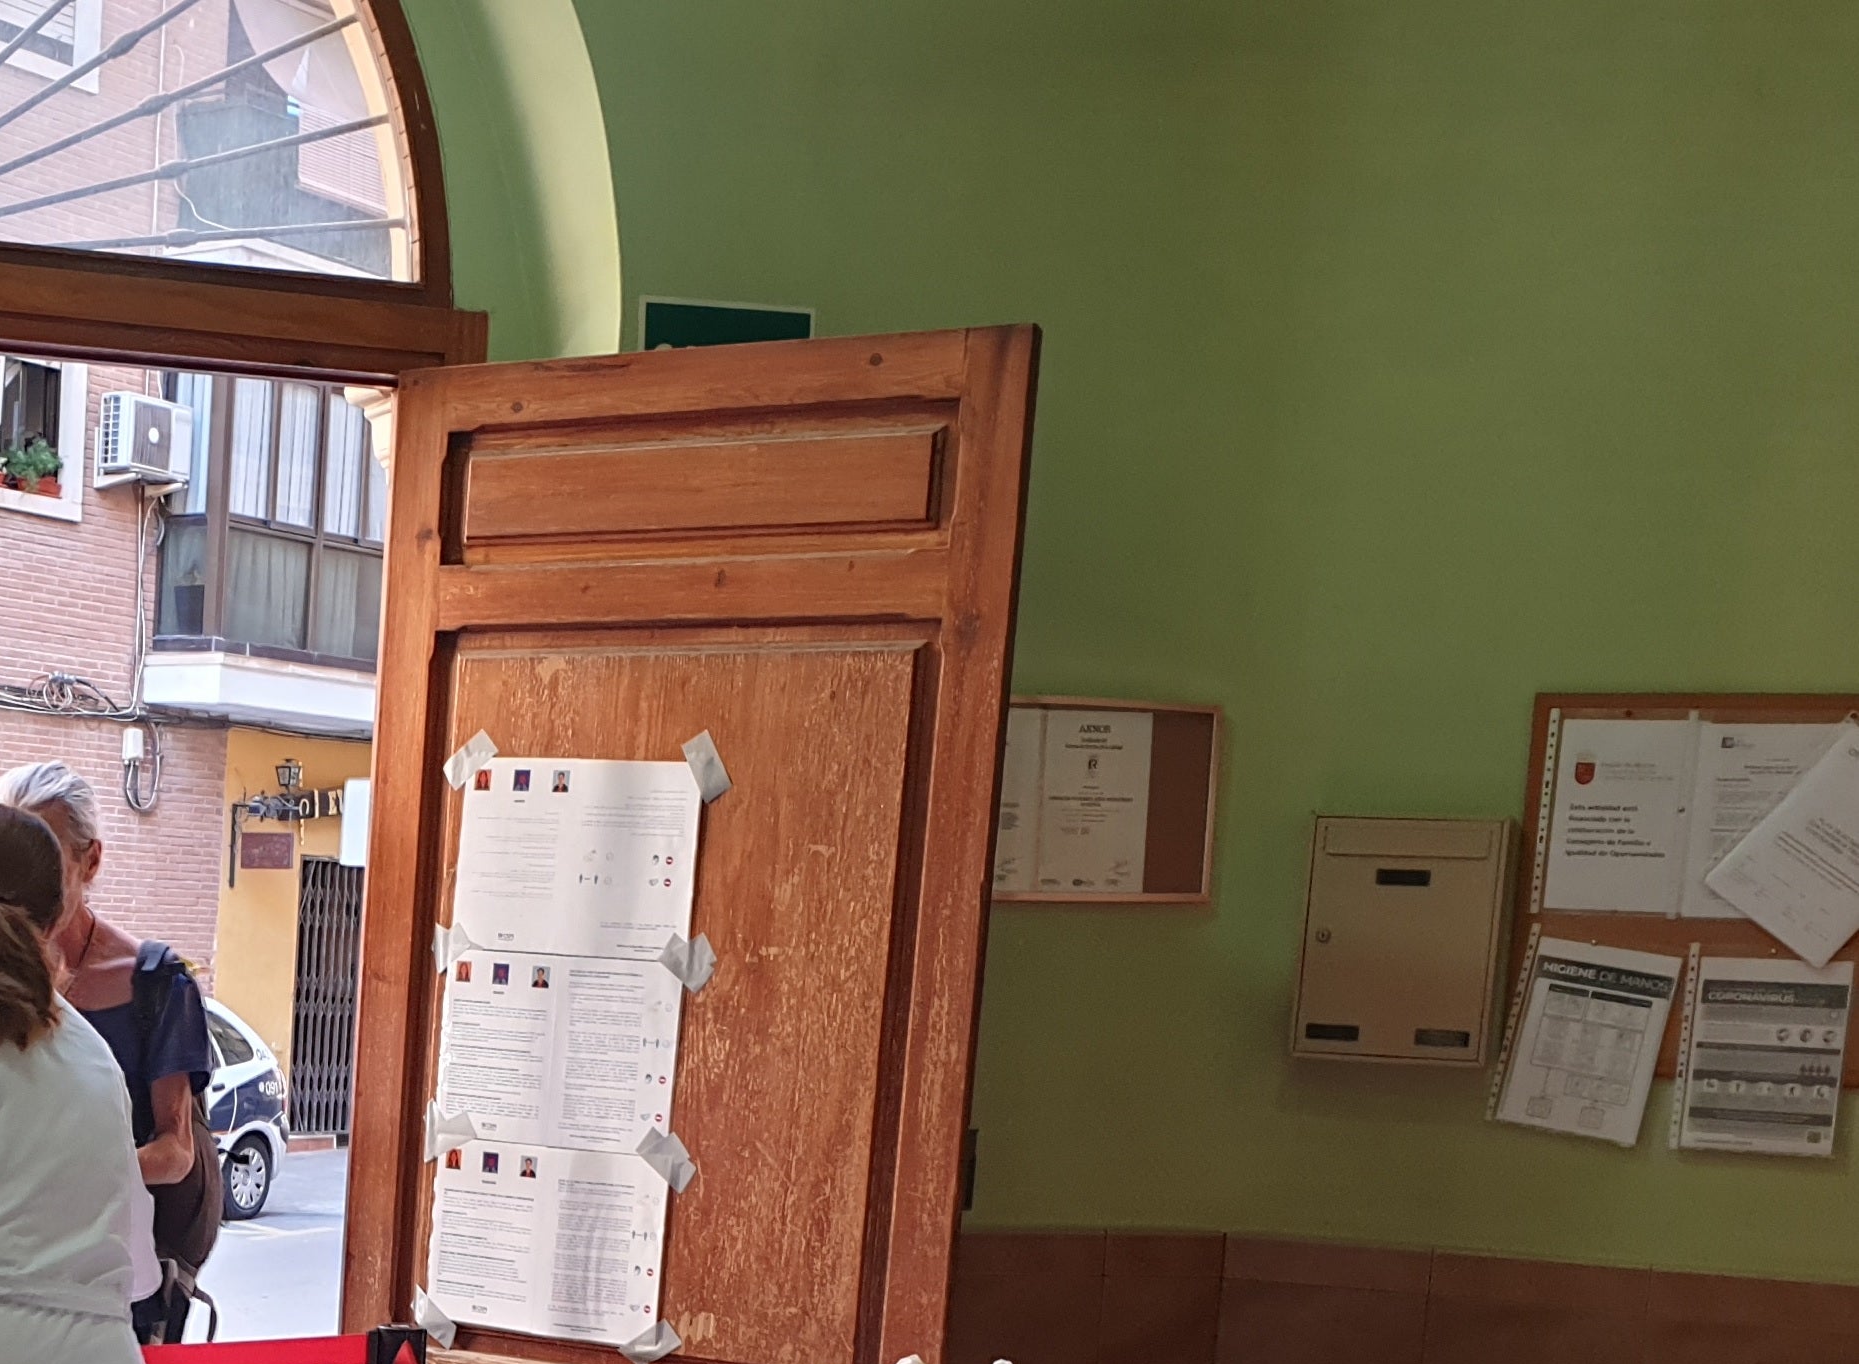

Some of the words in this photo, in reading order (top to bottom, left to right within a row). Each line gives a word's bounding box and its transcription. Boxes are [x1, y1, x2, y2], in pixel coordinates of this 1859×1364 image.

[1543, 961, 1597, 980] HIGIENE
[1599, 970, 1617, 984] DE
[1619, 975, 1669, 993] MANOS
[1708, 990, 1796, 1004] CORONAVIRUS
